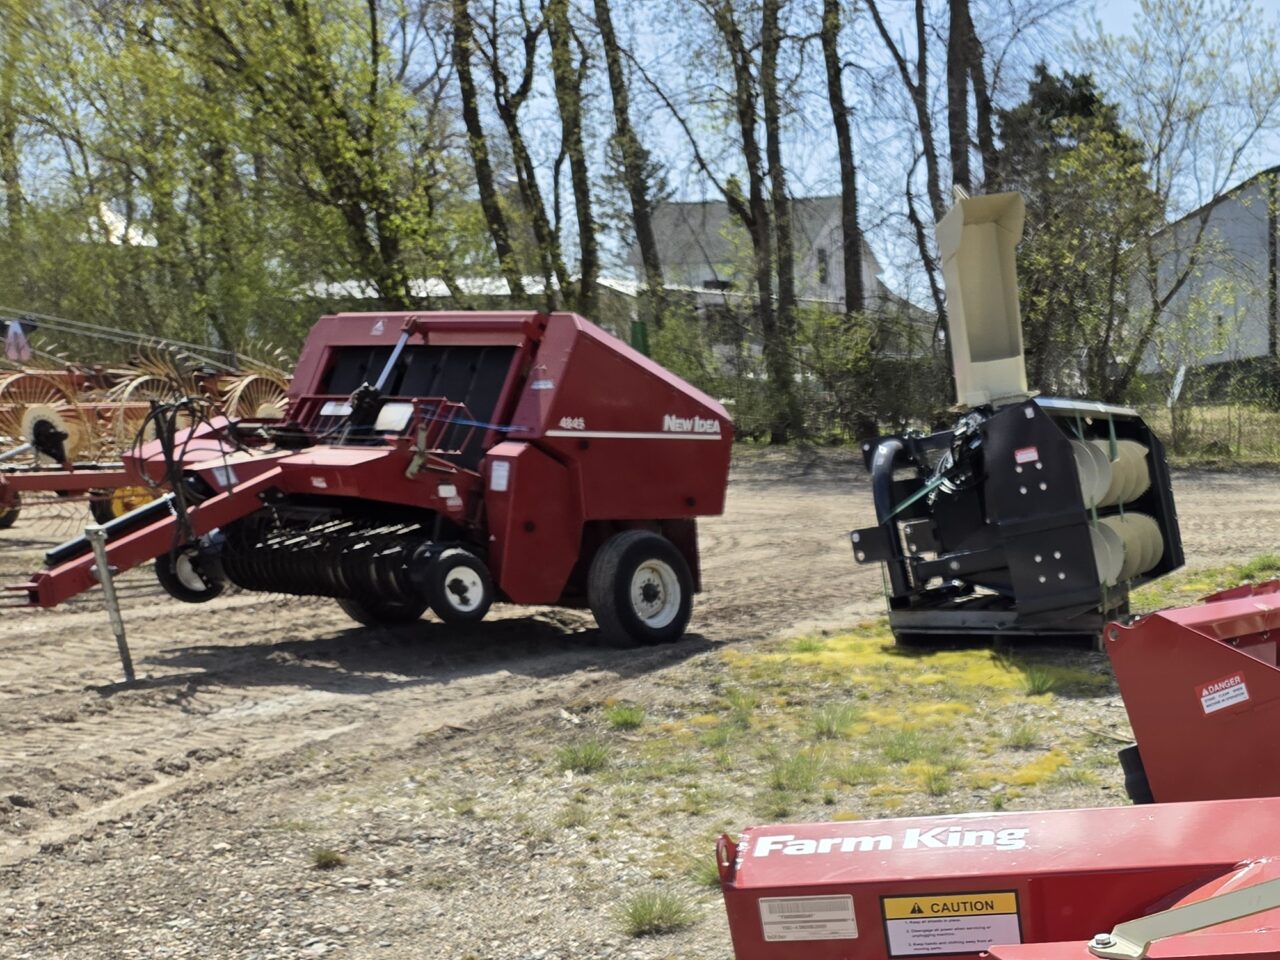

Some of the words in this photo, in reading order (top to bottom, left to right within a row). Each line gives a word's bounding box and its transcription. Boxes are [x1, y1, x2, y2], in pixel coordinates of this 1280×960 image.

[1207, 675, 1241, 694] DANGER
[754, 834, 893, 857] Farm
[903, 826, 1030, 851] King
[931, 900, 994, 913] CAUTION
